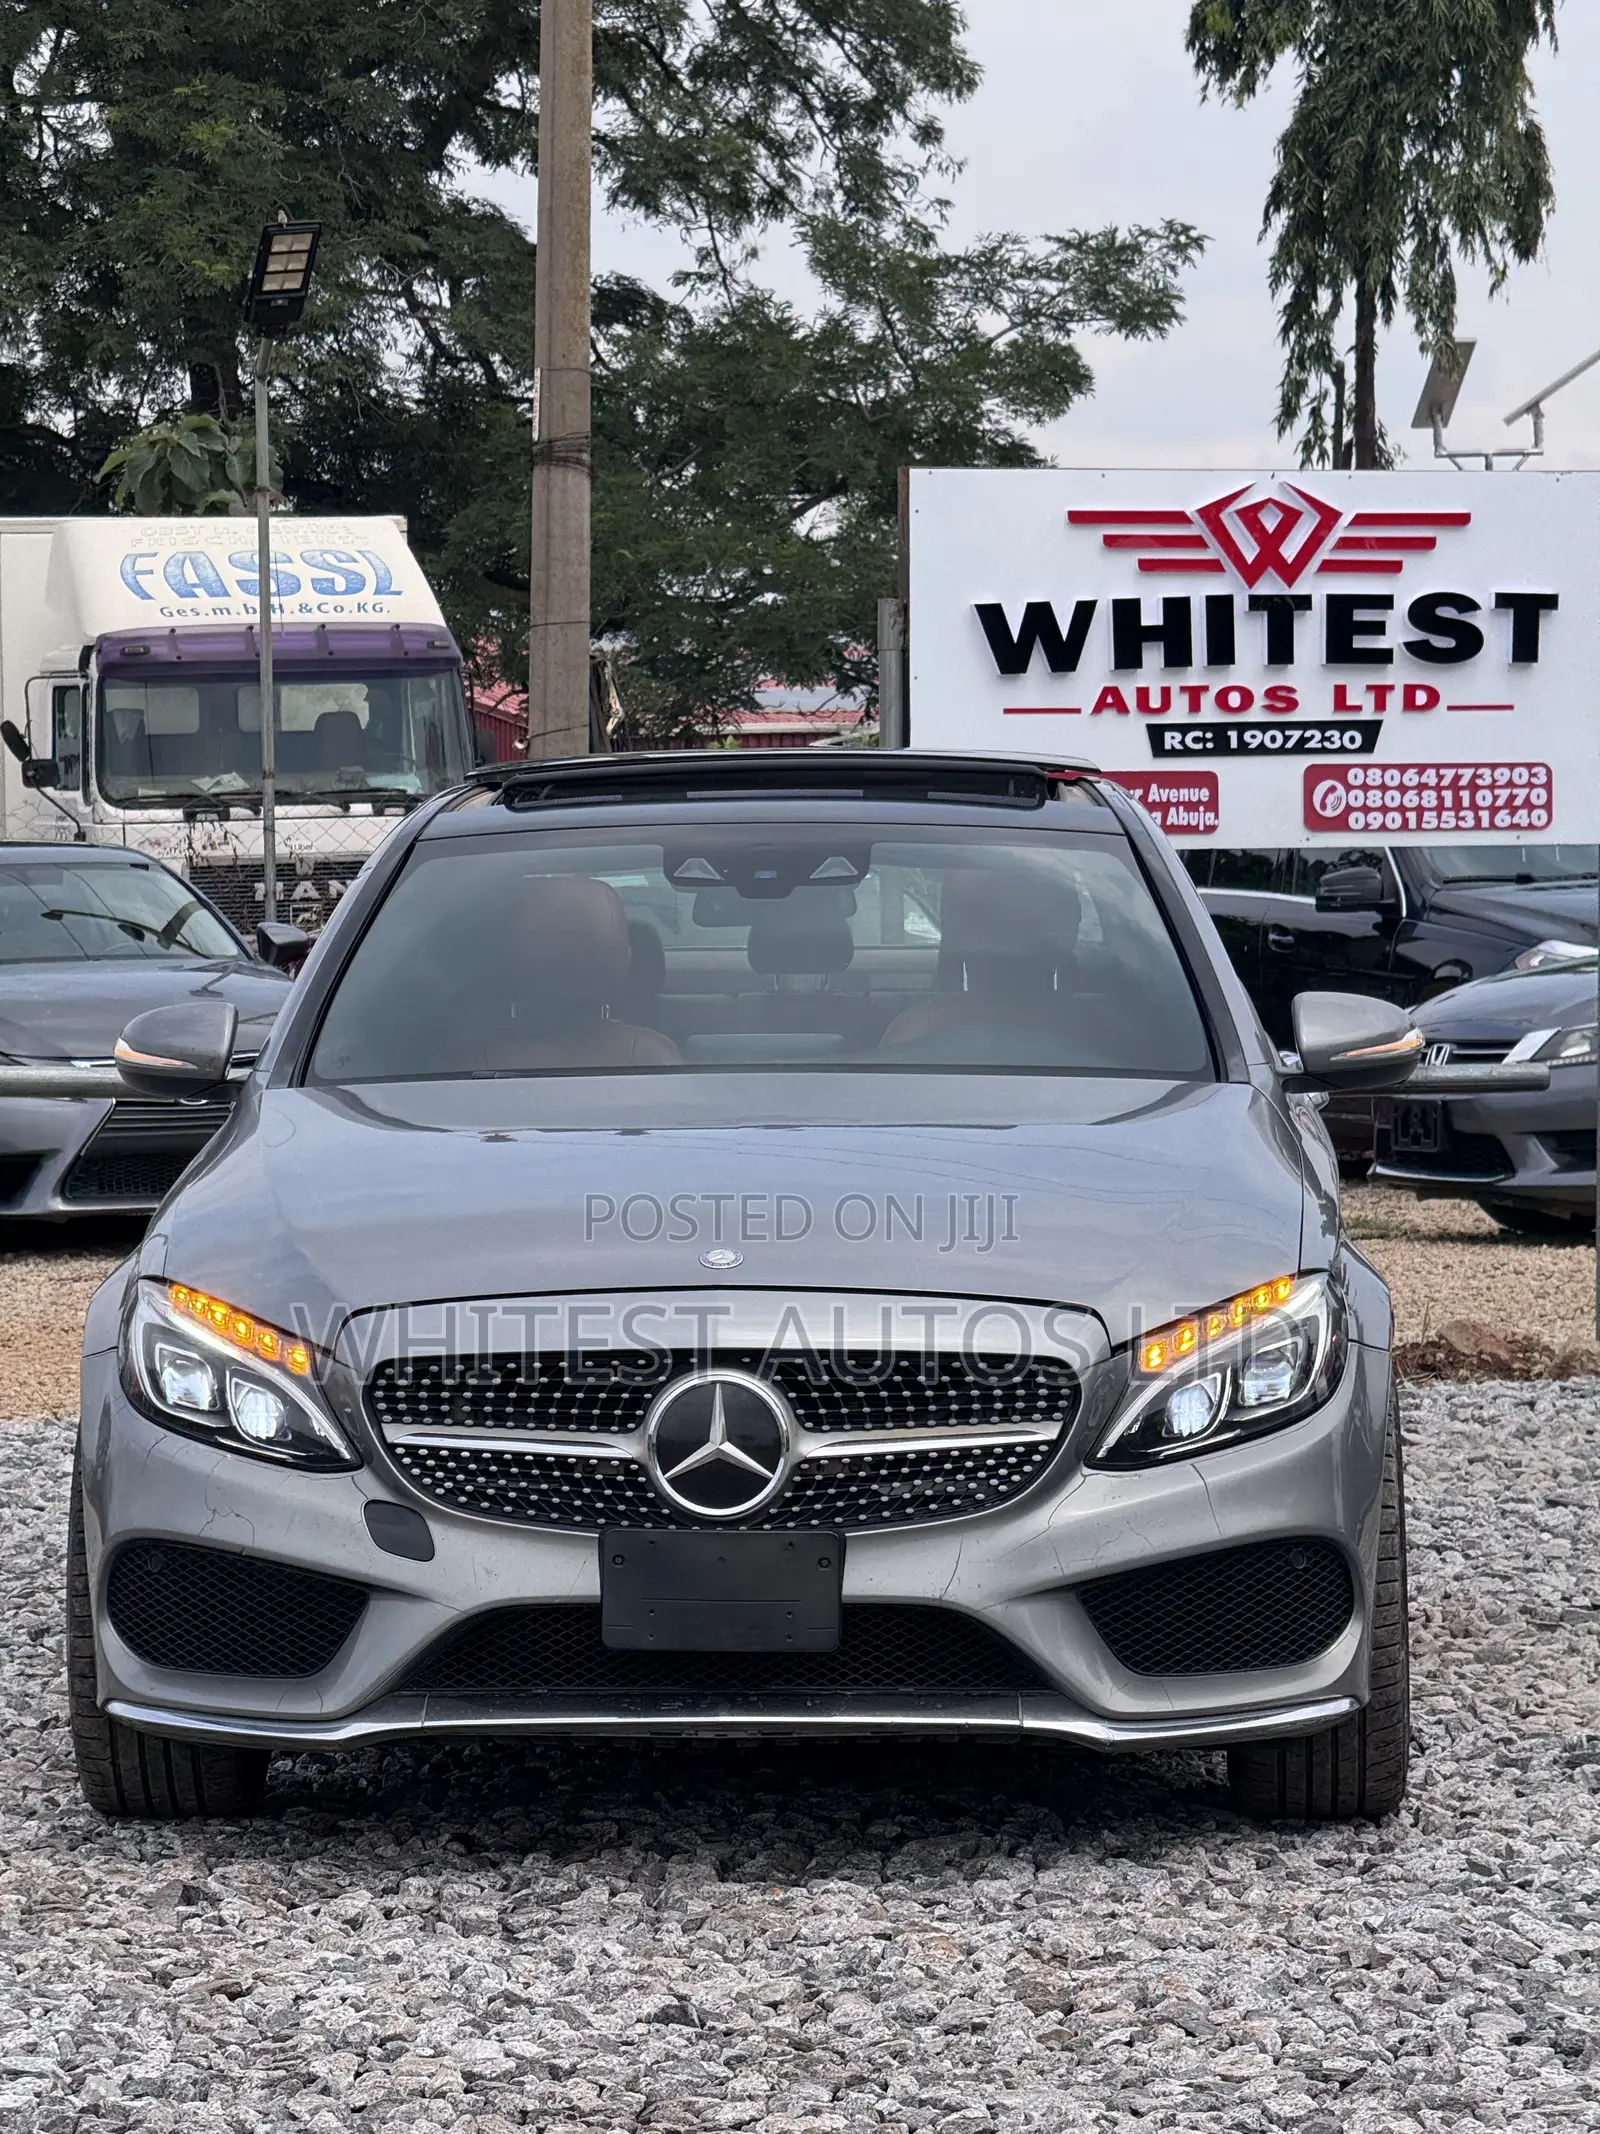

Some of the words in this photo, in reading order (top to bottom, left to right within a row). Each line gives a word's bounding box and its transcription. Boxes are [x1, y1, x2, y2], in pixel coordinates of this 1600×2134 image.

[120, 549, 404, 600] FASSL
[974, 591, 1559, 675] WHITEST
[1089, 684, 1300, 714] AUTOS
[1333, 683, 1441, 713] LTD
[1163, 731, 1214, 750] RC:
[1226, 728, 1363, 750] 1907230
[1347, 767, 1548, 787] 08064773903
[1147, 783, 1210, 803] Avenue
[1347, 787, 1548, 809] 08068110770
[1165, 805, 1219, 831] Abuja.
[1347, 808, 1549, 831] 09015531640
